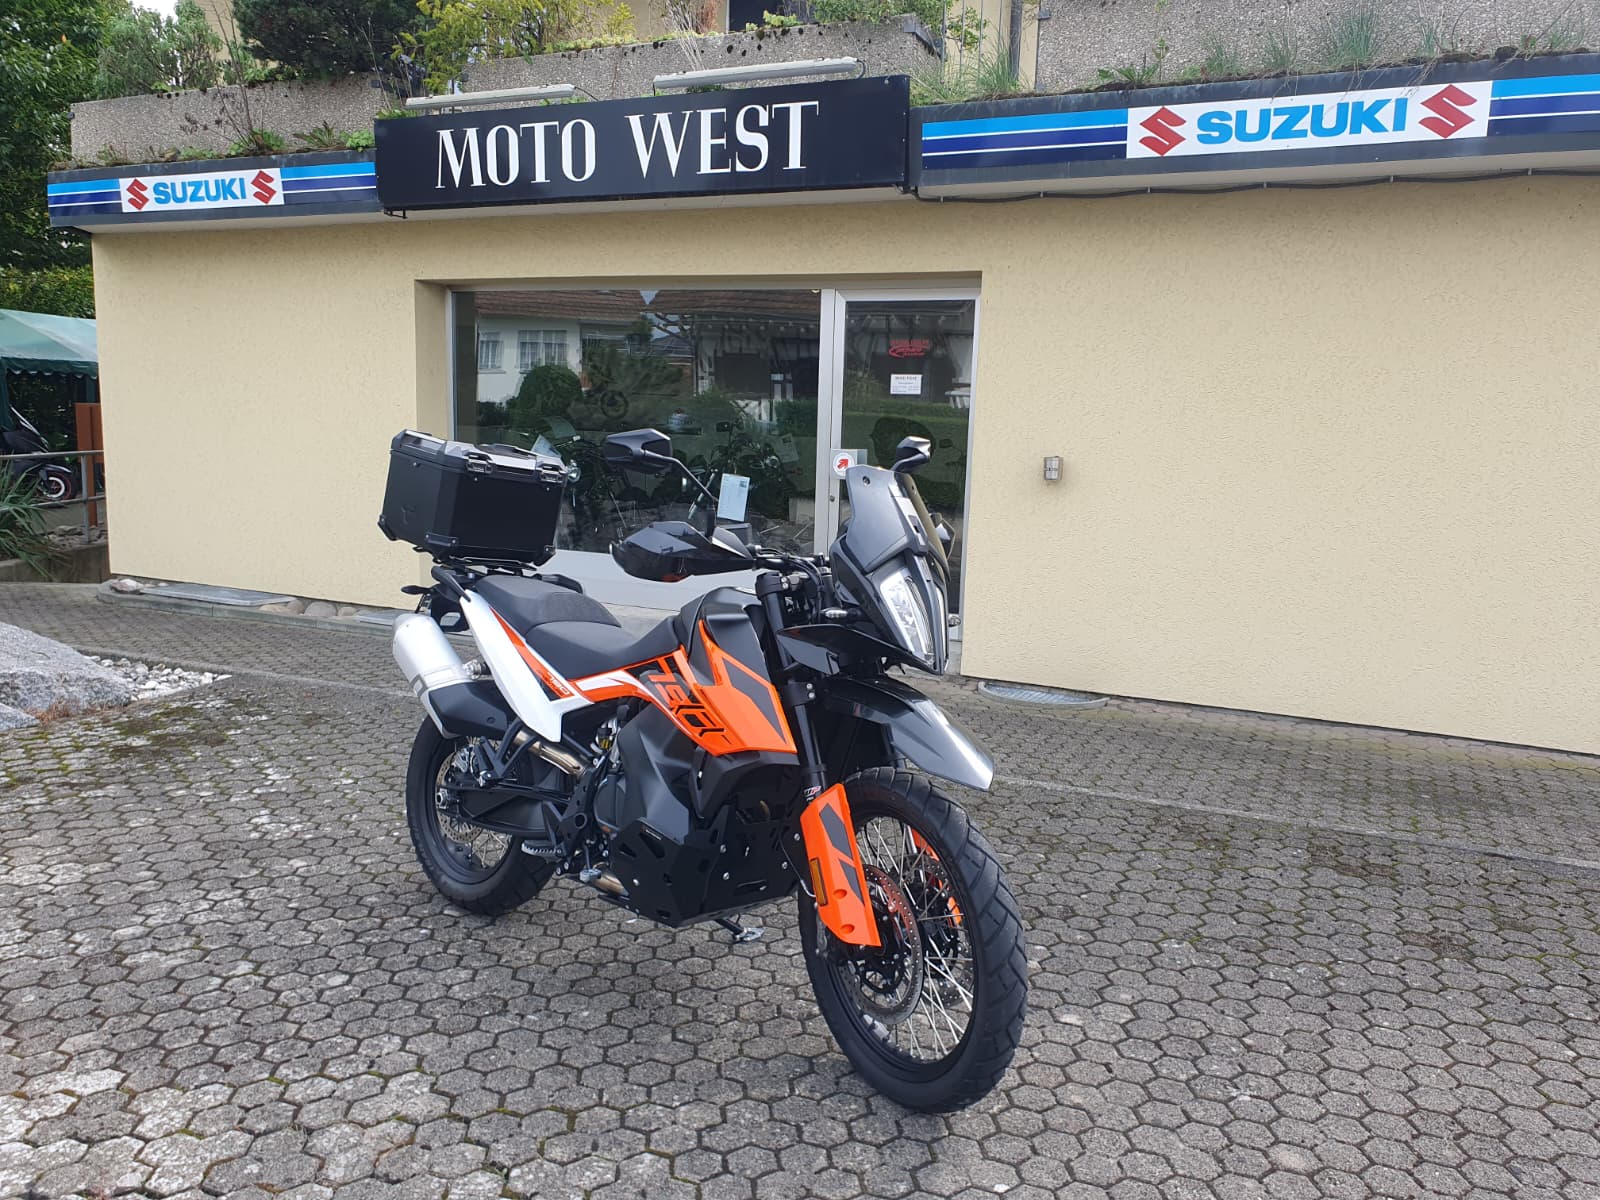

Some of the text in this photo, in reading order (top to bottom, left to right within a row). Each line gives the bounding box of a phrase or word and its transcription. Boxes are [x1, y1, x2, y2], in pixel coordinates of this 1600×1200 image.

[435, 101, 819, 189] MOTO WEST
[1196, 97, 1408, 145] SUZUKI
[153, 177, 247, 205] SUZUKI
